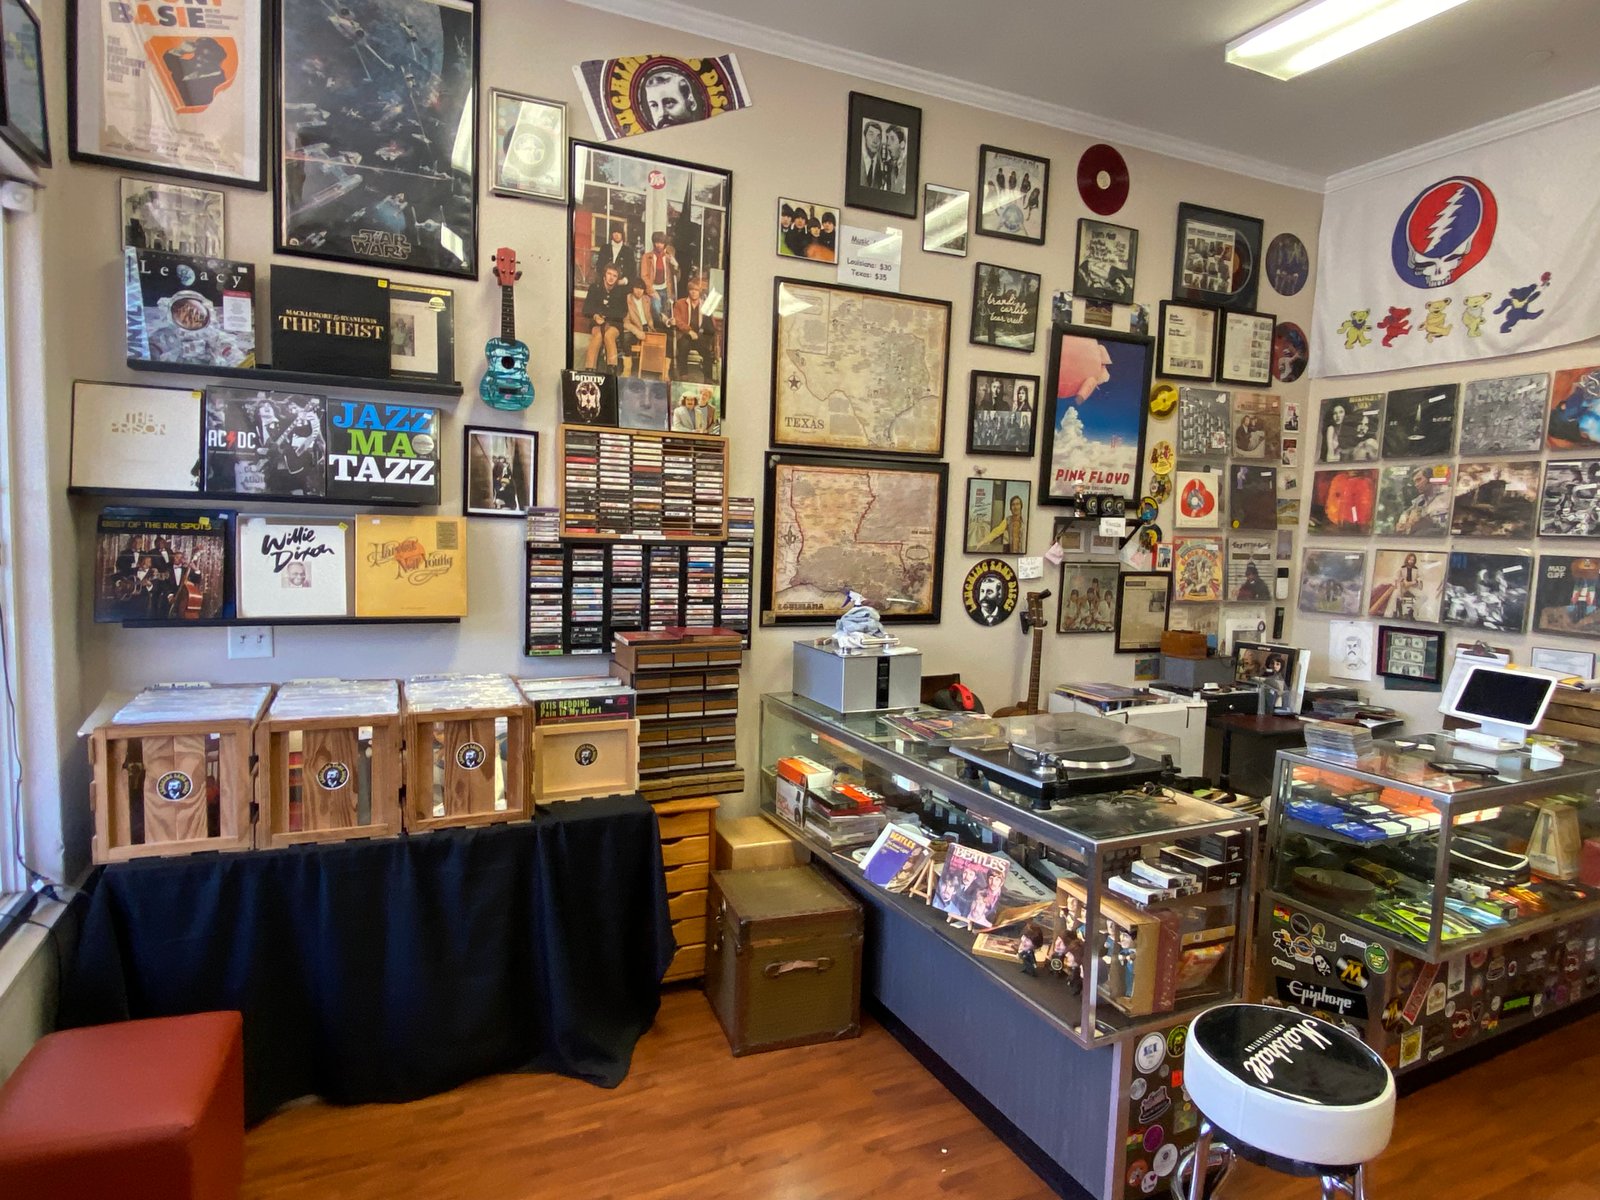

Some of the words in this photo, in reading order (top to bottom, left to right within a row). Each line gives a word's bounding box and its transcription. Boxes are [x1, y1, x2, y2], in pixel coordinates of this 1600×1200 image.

[110, 2, 206, 28] BASIE
[352, 229, 411, 250] STAR
[352, 238, 411, 260] WARS
[851, 236, 870, 246] Music
[140, 259, 241, 288] Legacy
[279, 315, 320, 333] THE
[326, 320, 384, 340] HEIST
[570, 371, 605, 385] Tommy
[333, 402, 434, 434] JAZZ
[785, 417, 825, 430] TEXAS
[348, 429, 417, 458] MA
[329, 454, 434, 486] TAZZ
[1056, 469, 1086, 482] PINK
[1089, 471, 1130, 485] FLOYD
[261, 527, 316, 555] Willie
[270, 544, 335, 573] Dixon
[541, 701, 557, 710] OTIS
[560, 699, 590, 708] REDDING
[541, 709, 557, 718] Pain
[582, 706, 602, 715] Heart
[890, 831, 916, 849] BEATLES
[955, 846, 1007, 872] BEATLES
[1286, 980, 1352, 1014] Epiphone
[1243, 1018, 1332, 1084] Marshall
